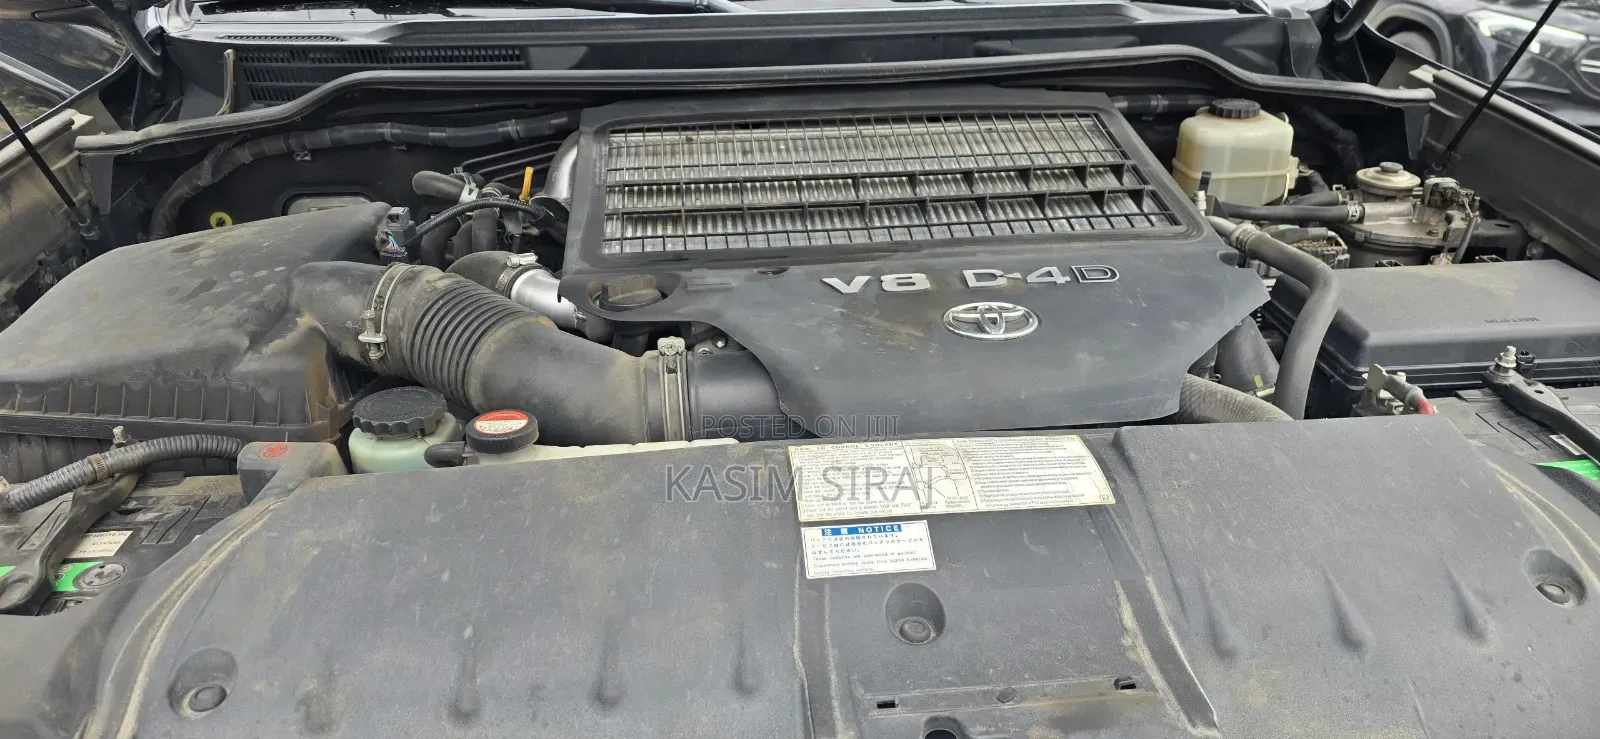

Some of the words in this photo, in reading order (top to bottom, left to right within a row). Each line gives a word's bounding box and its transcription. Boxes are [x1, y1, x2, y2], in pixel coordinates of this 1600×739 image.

[821, 272, 931, 295] V8
[962, 264, 1120, 289] D-4D
[858, 524, 900, 534] NOTICE
